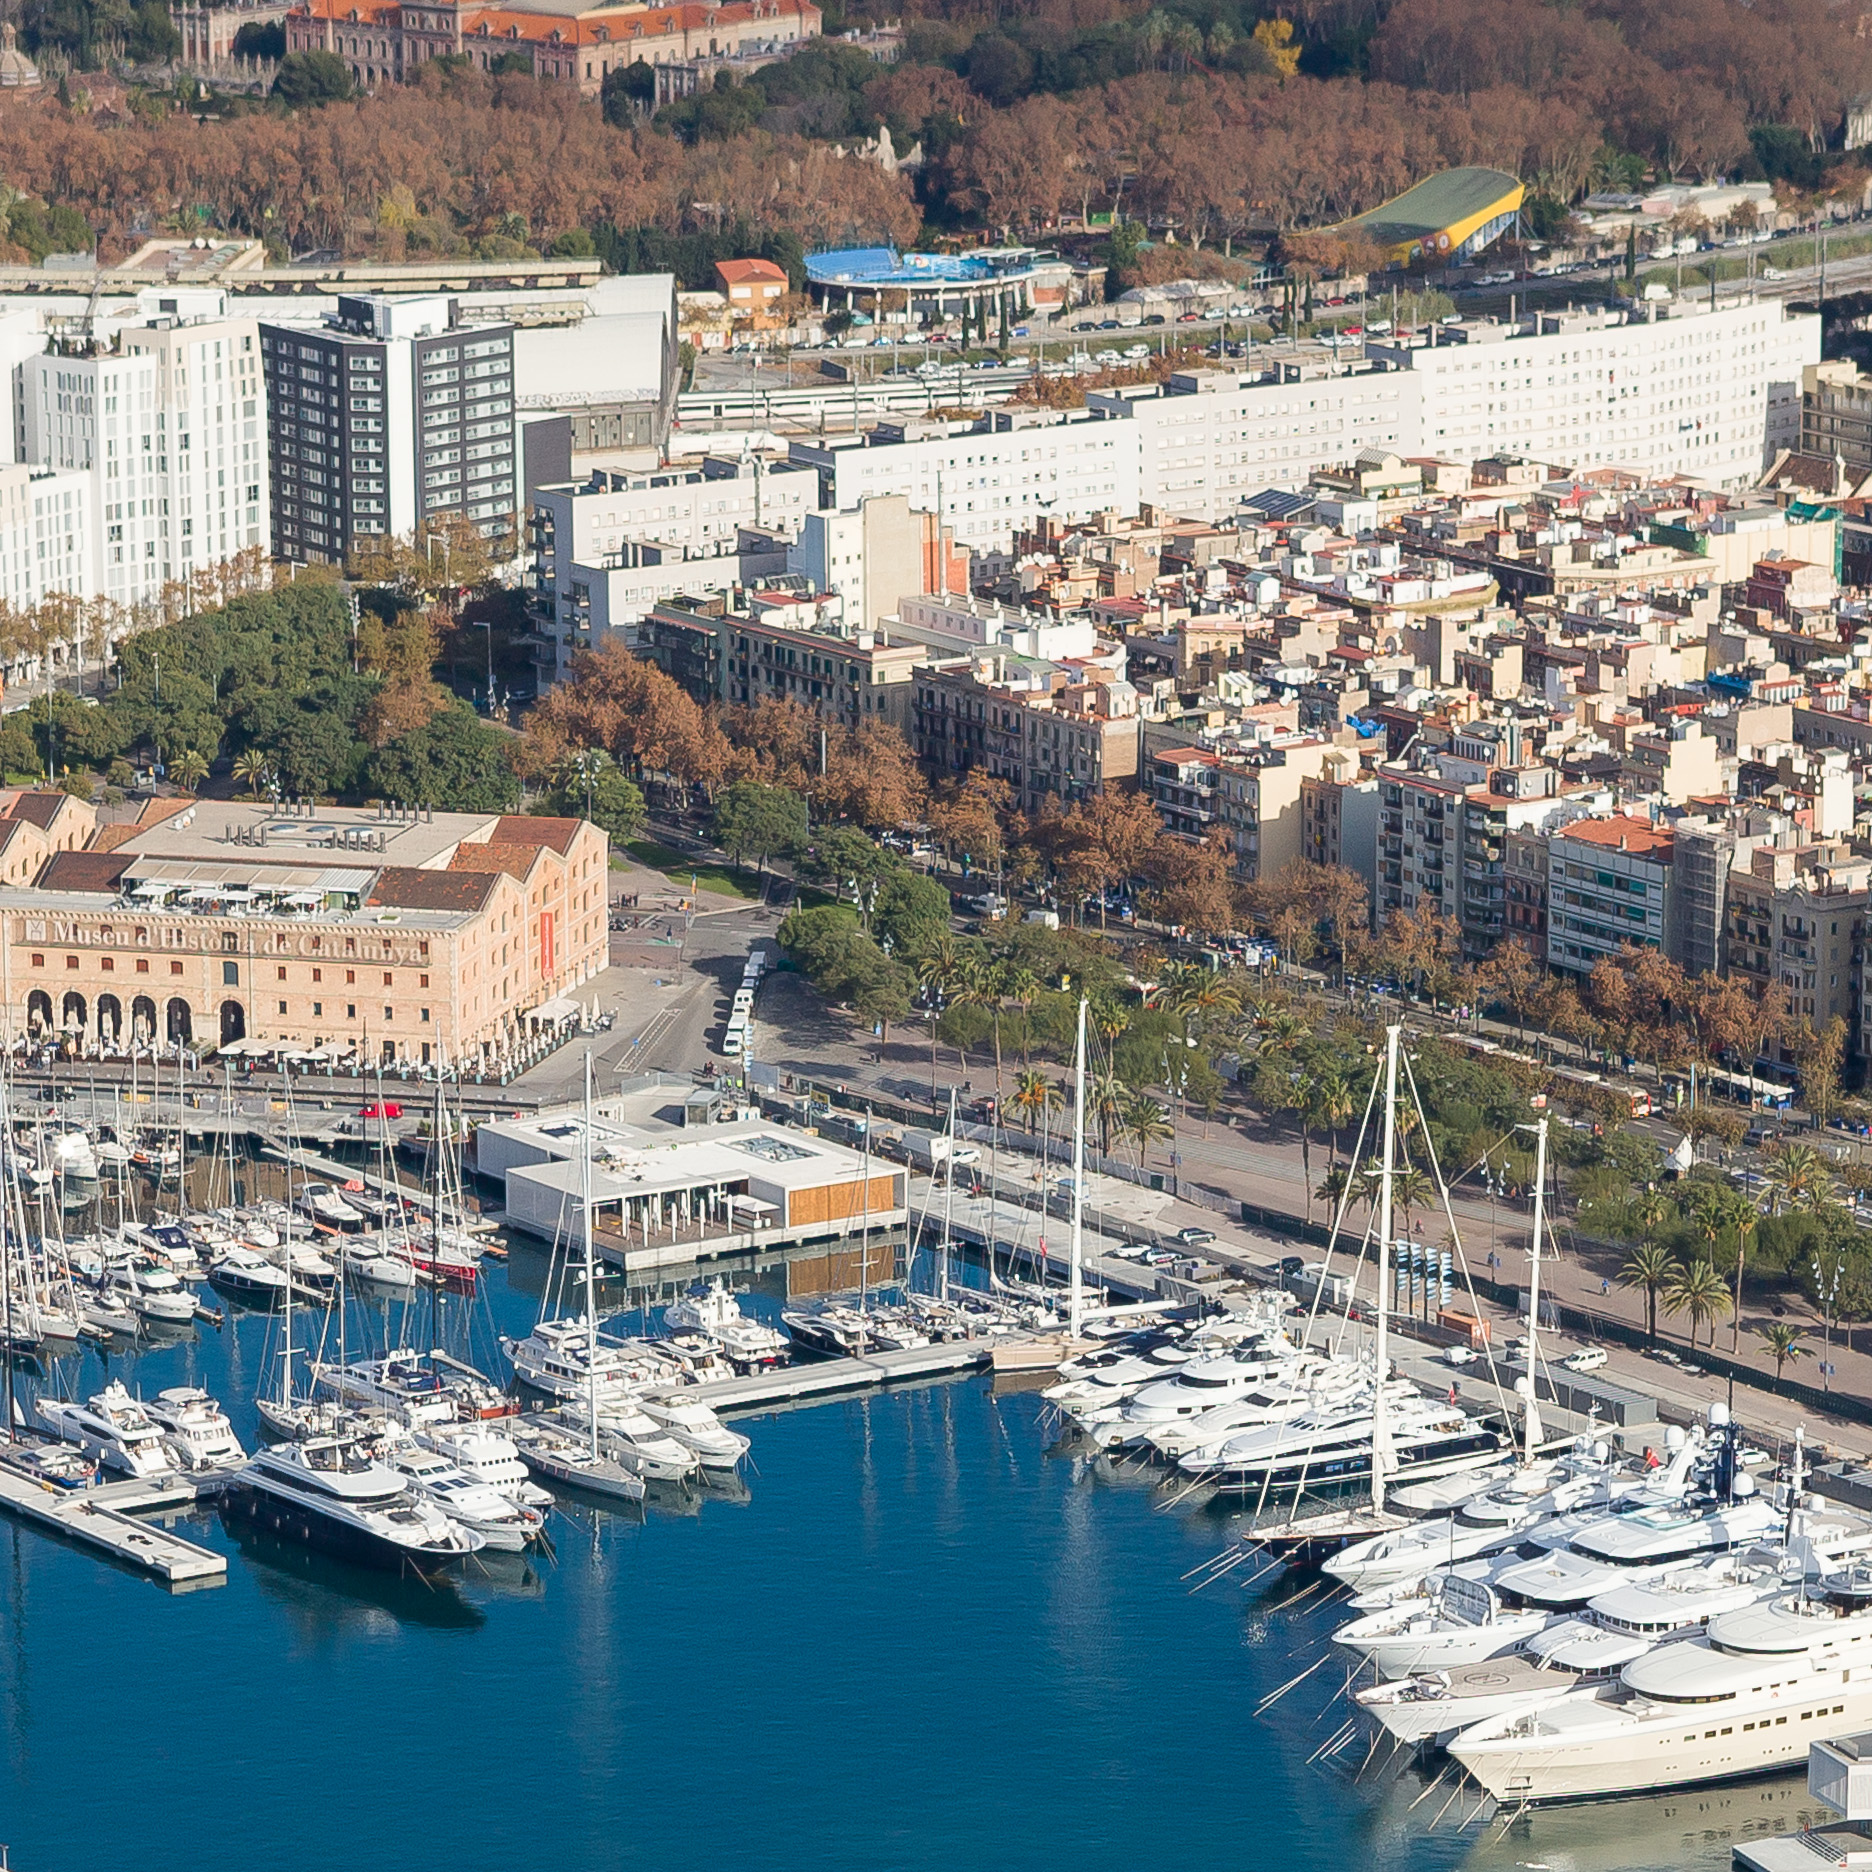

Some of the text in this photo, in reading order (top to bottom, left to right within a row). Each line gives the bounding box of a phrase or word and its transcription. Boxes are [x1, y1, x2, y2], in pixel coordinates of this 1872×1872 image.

[53, 920, 129, 946] Museu
[263, 933, 292, 955] de
[299, 934, 422, 966] Catalunya
